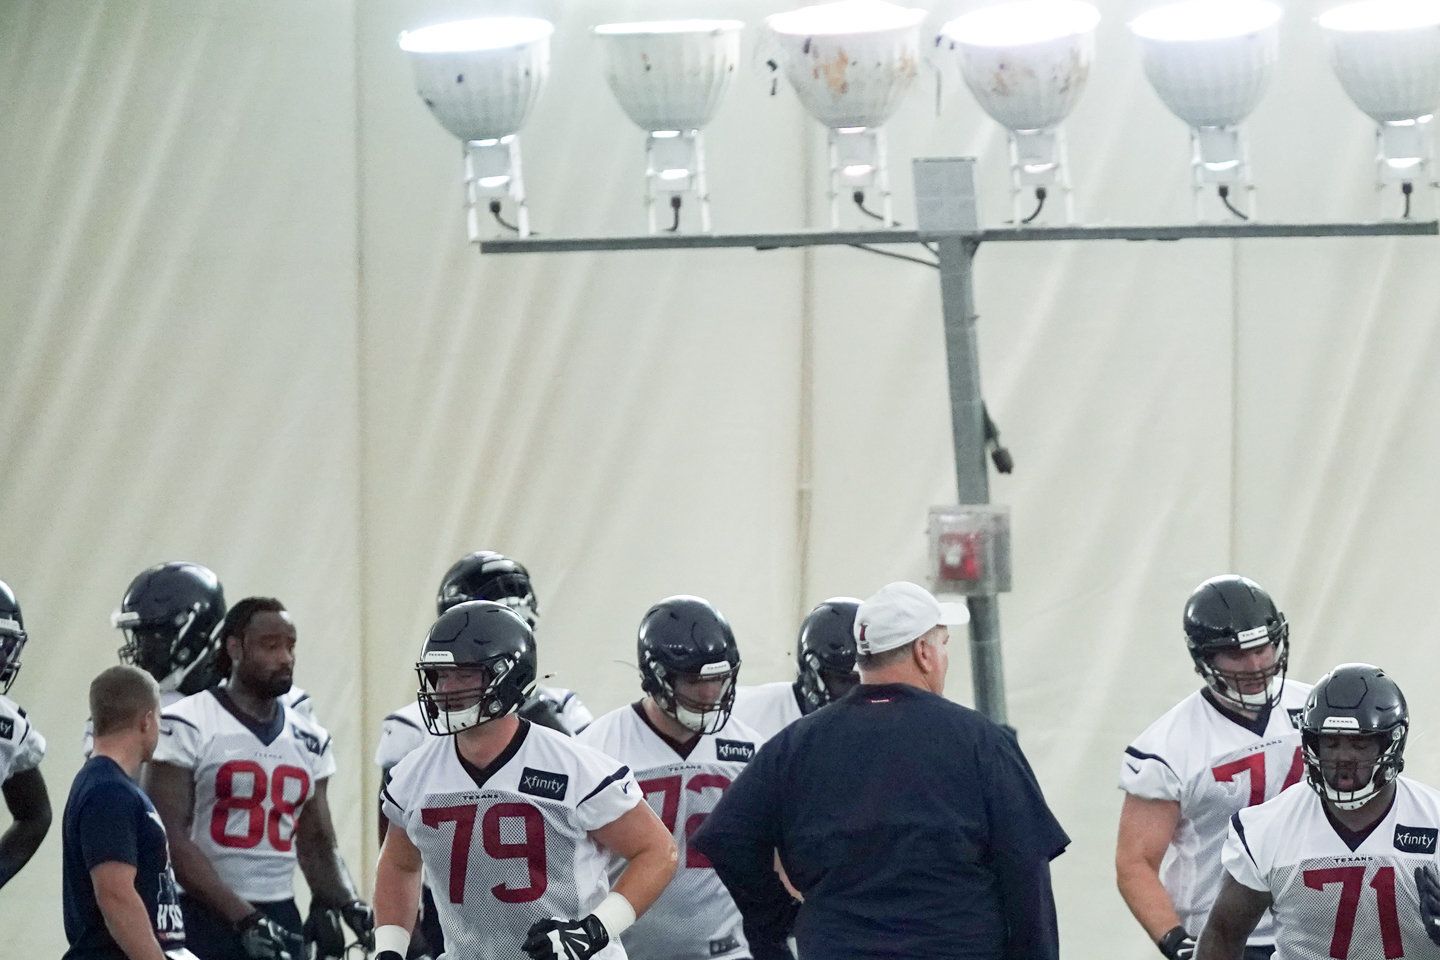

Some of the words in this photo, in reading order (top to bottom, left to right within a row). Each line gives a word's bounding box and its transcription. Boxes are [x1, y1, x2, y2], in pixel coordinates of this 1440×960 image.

[719, 743, 754, 763] xfinity
[210, 759, 310, 852] 88
[522, 775, 565, 793] xfinity
[421, 802, 548, 904] 79
[1396, 832, 1436, 849] xfinity
[1303, 866, 1404, 960] 71
